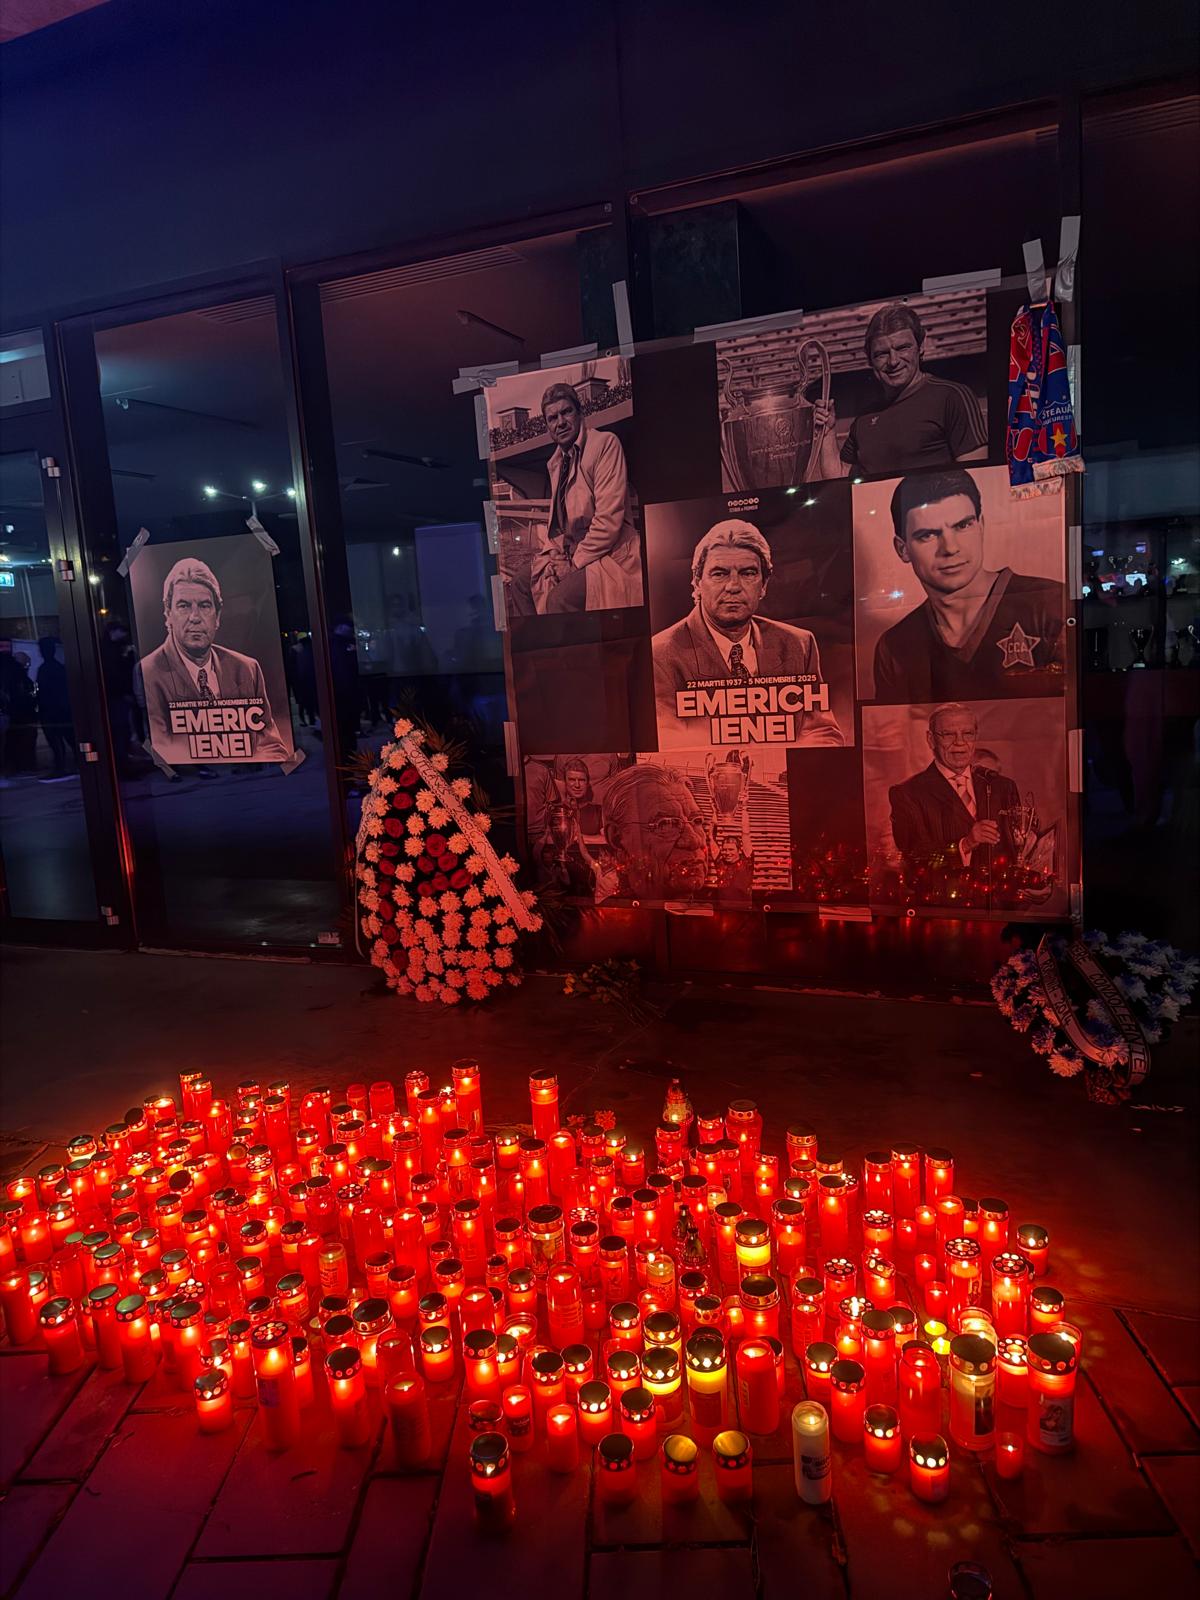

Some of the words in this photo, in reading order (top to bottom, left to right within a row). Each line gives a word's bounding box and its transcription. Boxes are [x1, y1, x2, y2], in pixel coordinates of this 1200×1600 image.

[1042, 403, 1072, 419] STEAUA
[1008, 642, 1028, 653] CCA
[687, 681, 696, 689] 22
[697, 679, 725, 688] MARTIE
[726, 678, 743, 687] 1937
[754, 676, 796, 685] NOIEMBRIE
[797, 674, 817, 682] 2025
[676, 684, 830, 717] EMERICH
[170, 706, 265, 733] EMERIC
[711, 715, 795, 744] IENEI
[189, 733, 252, 758] IENEI
